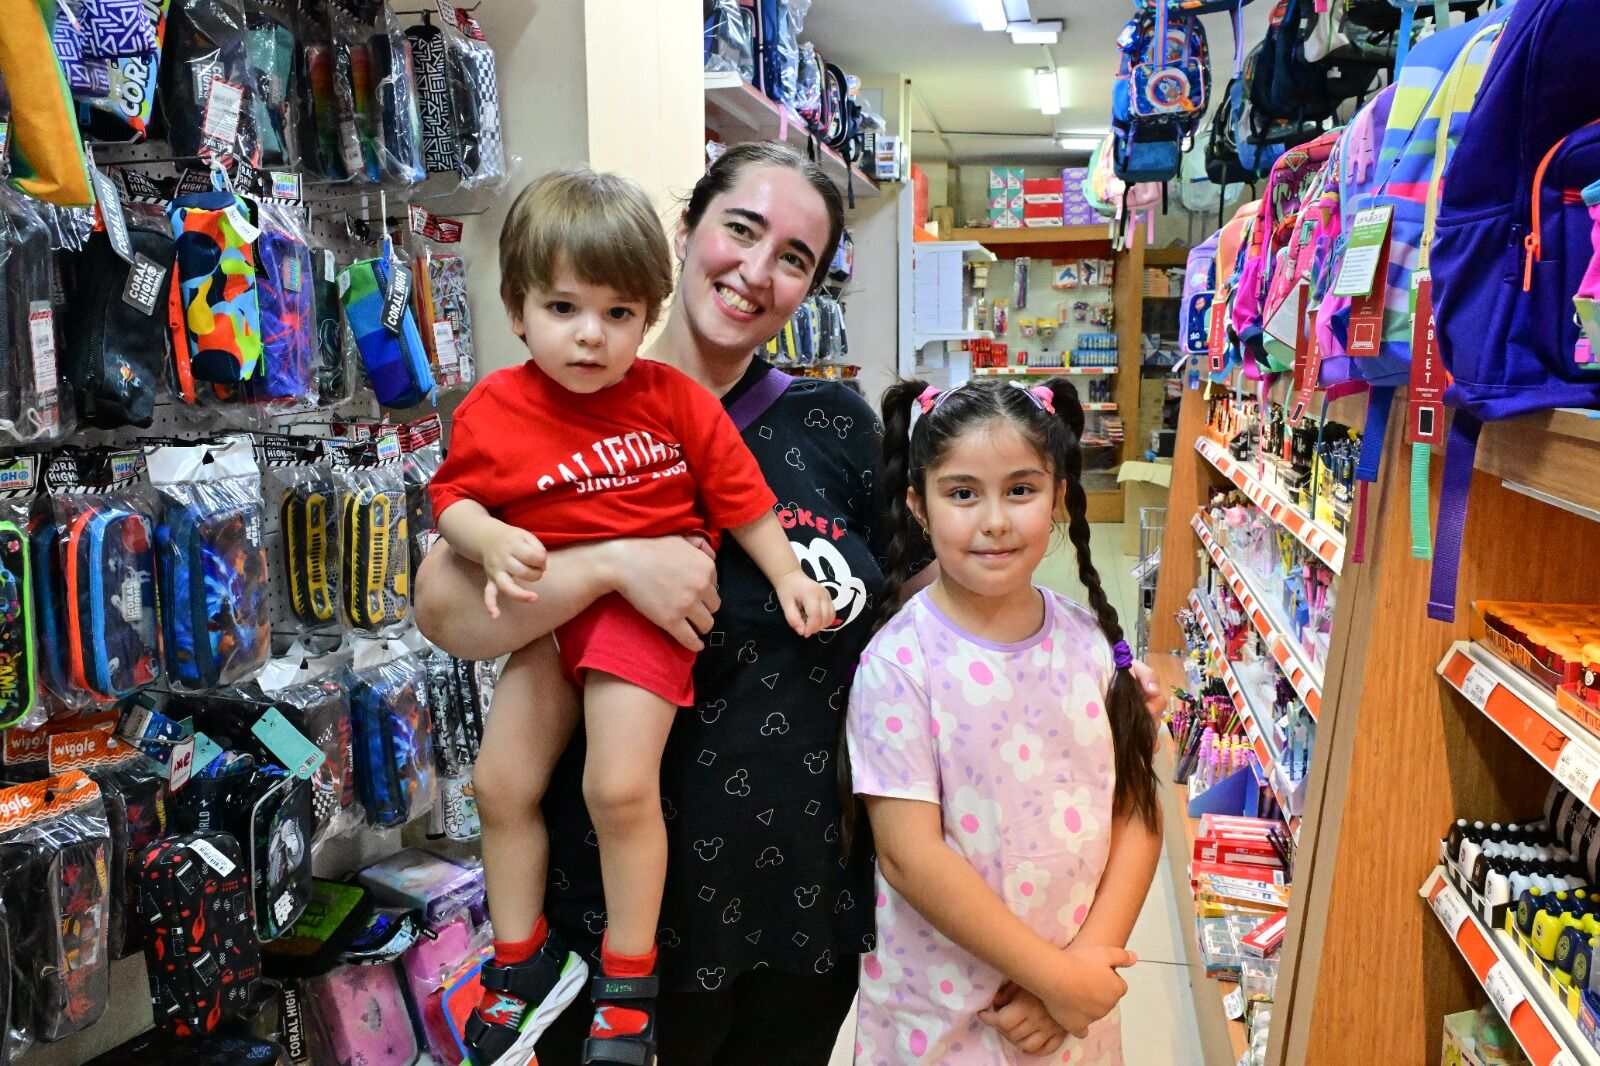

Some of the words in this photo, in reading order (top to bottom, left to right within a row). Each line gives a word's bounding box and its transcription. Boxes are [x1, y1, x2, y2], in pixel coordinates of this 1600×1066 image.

[104, 181, 116, 214] HIGH
[111, 214, 129, 255] CORAL
[128, 261, 148, 299] CORAL
[395, 269, 407, 296] HIGH
[388, 293, 404, 326] CORAL
[55, 737, 96, 757] wiggle
[285, 989, 298, 1018] HIGH
[288, 1017, 302, 1057] CORAL
